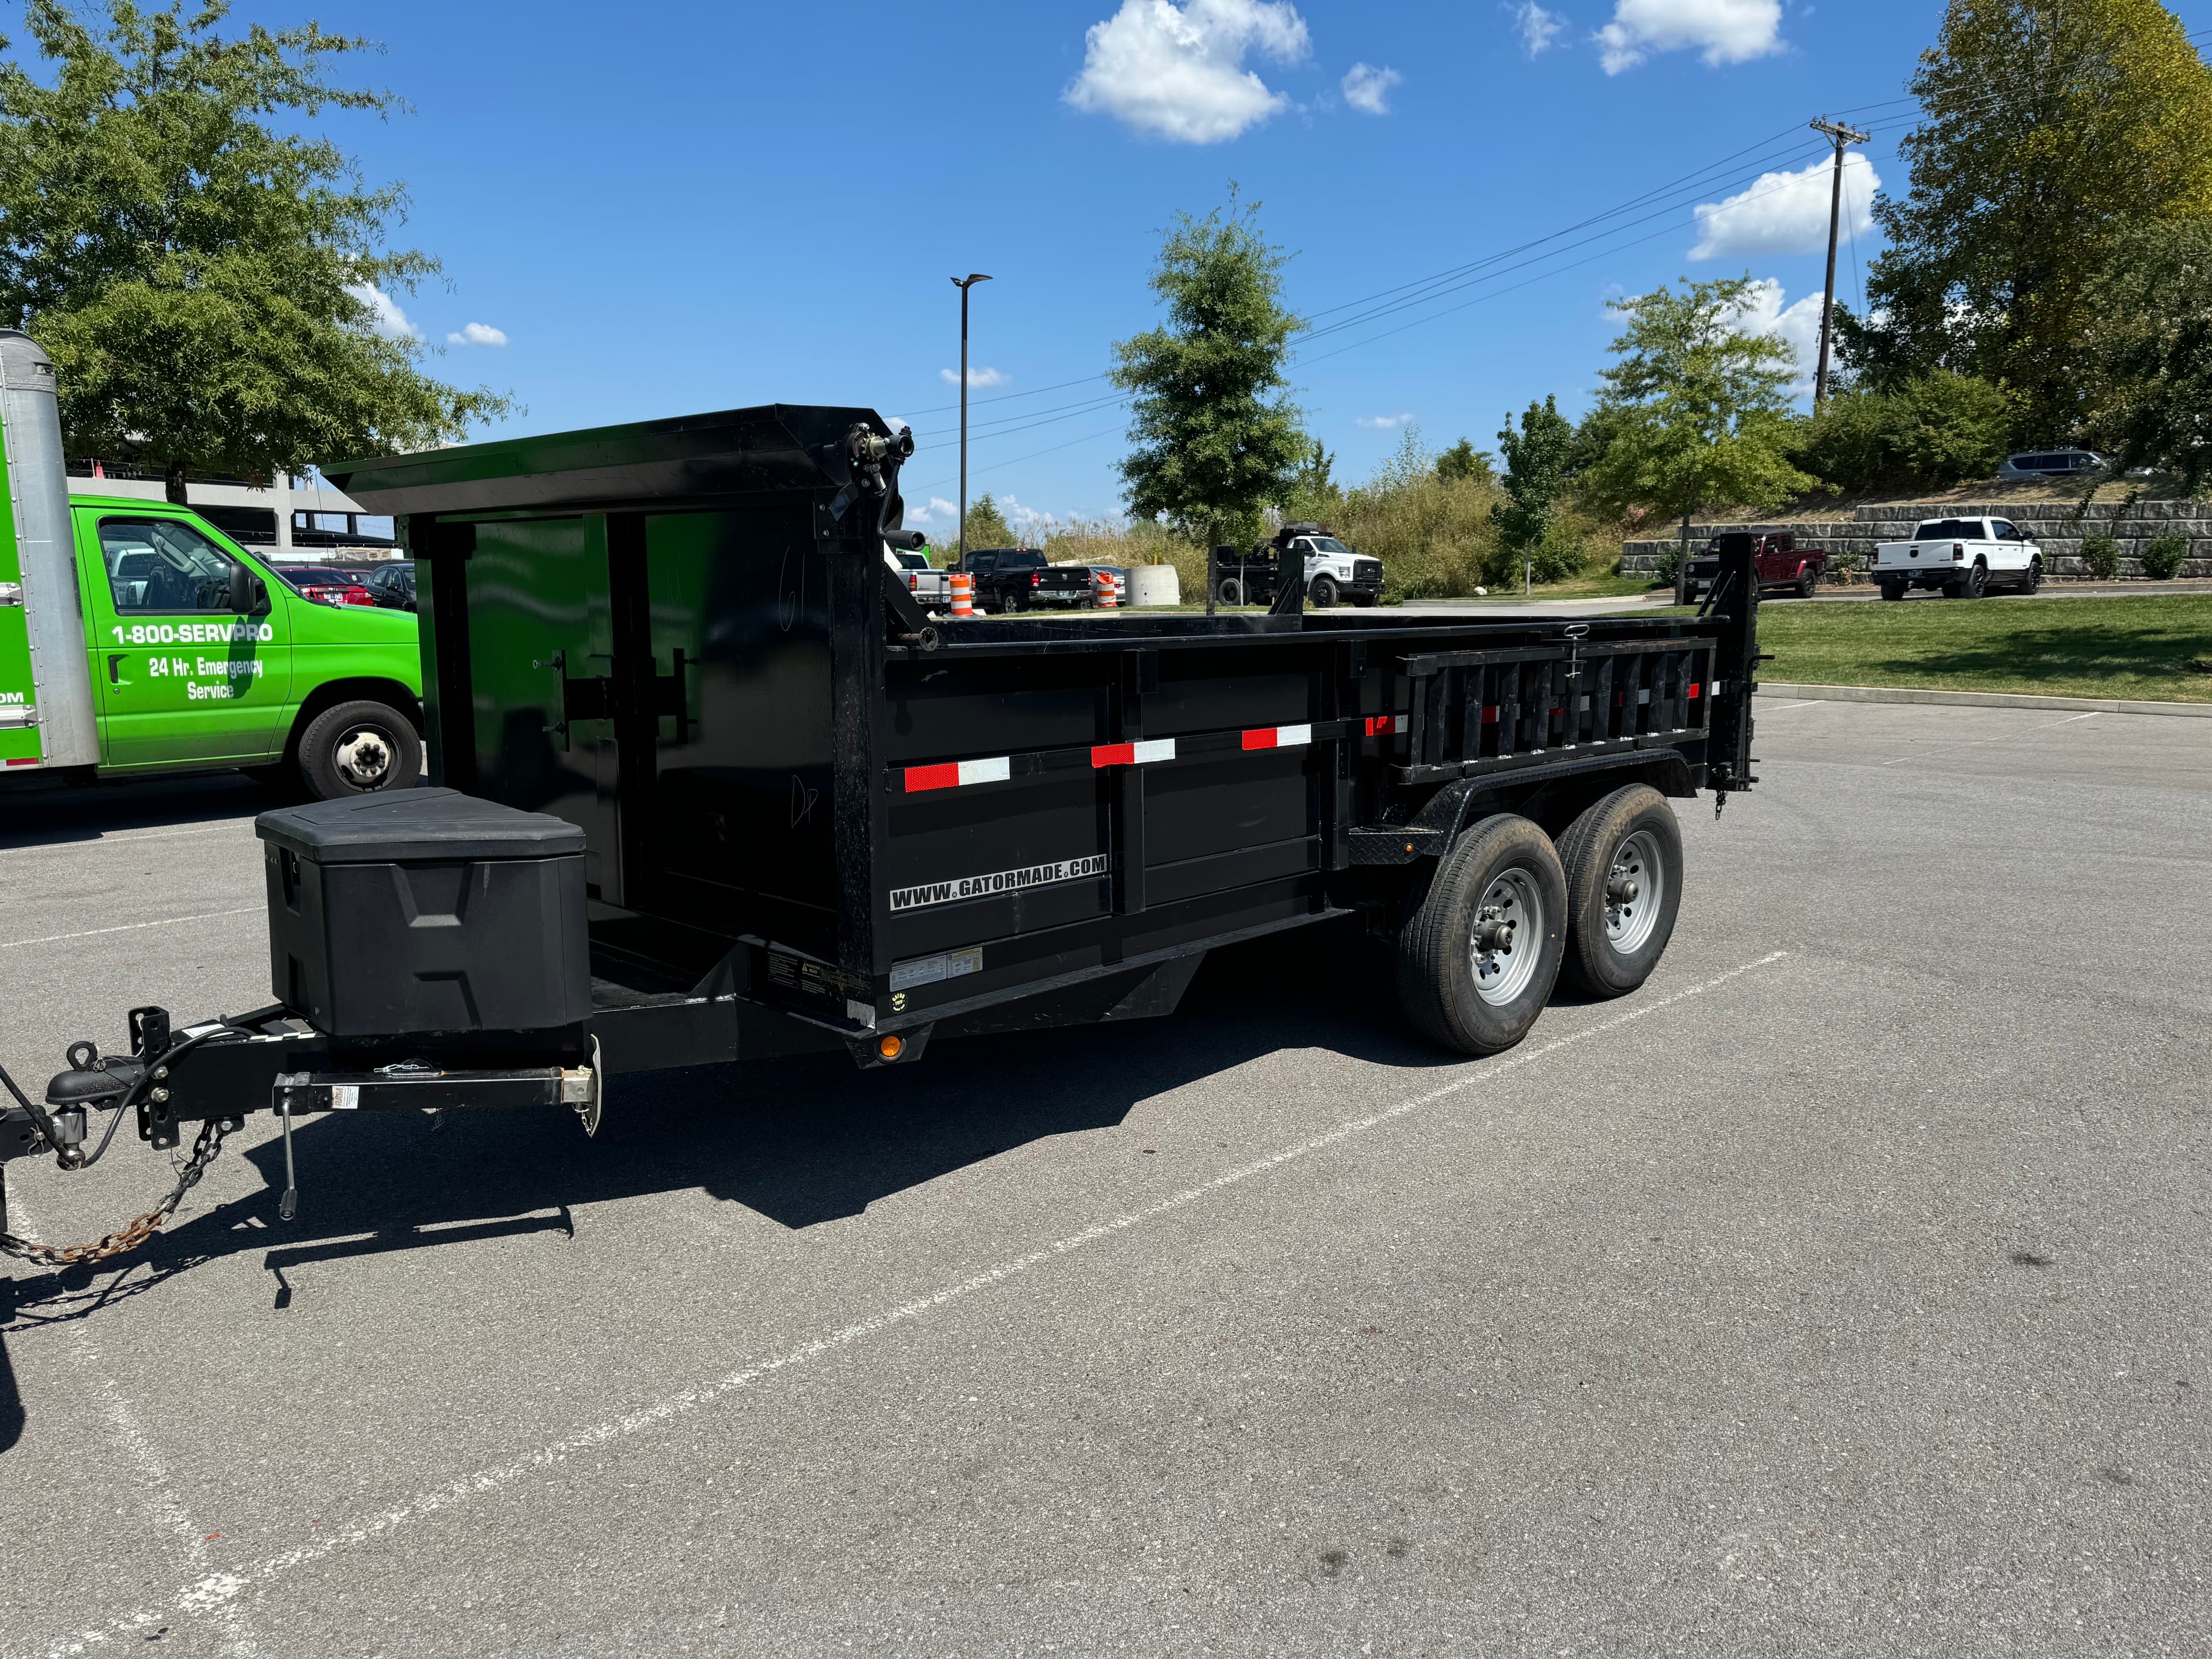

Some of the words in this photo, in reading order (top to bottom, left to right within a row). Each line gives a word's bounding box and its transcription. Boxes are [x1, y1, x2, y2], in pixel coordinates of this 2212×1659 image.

[112, 623, 273, 645] 1-800-SERVPRO
[149, 657, 169, 677] 24
[173, 657, 194, 676] Hr.
[196, 657, 263, 679] Emergency
[187, 681, 234, 700] Service
[892, 856, 1105, 909] WWW.GATORMADE.COM
